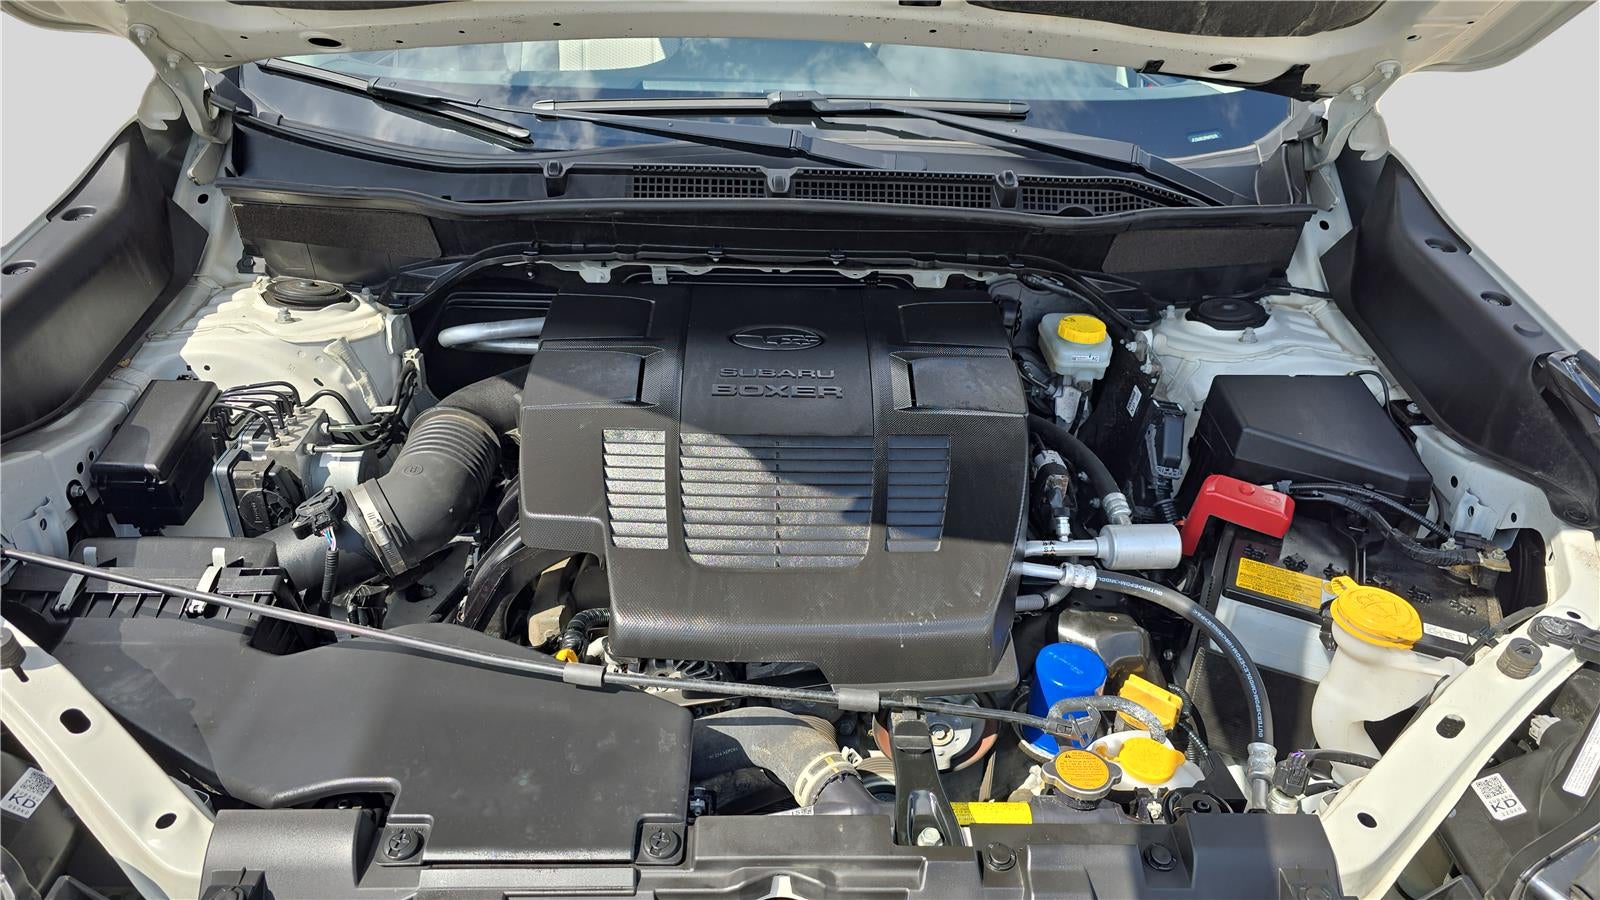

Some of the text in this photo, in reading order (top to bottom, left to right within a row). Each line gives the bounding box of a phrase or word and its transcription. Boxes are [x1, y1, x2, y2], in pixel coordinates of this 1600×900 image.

[719, 367, 835, 379] SUBARU
[711, 383, 843, 399] BOXER
[8, 793, 36, 808] KD
[1491, 798, 1517, 812] KD
